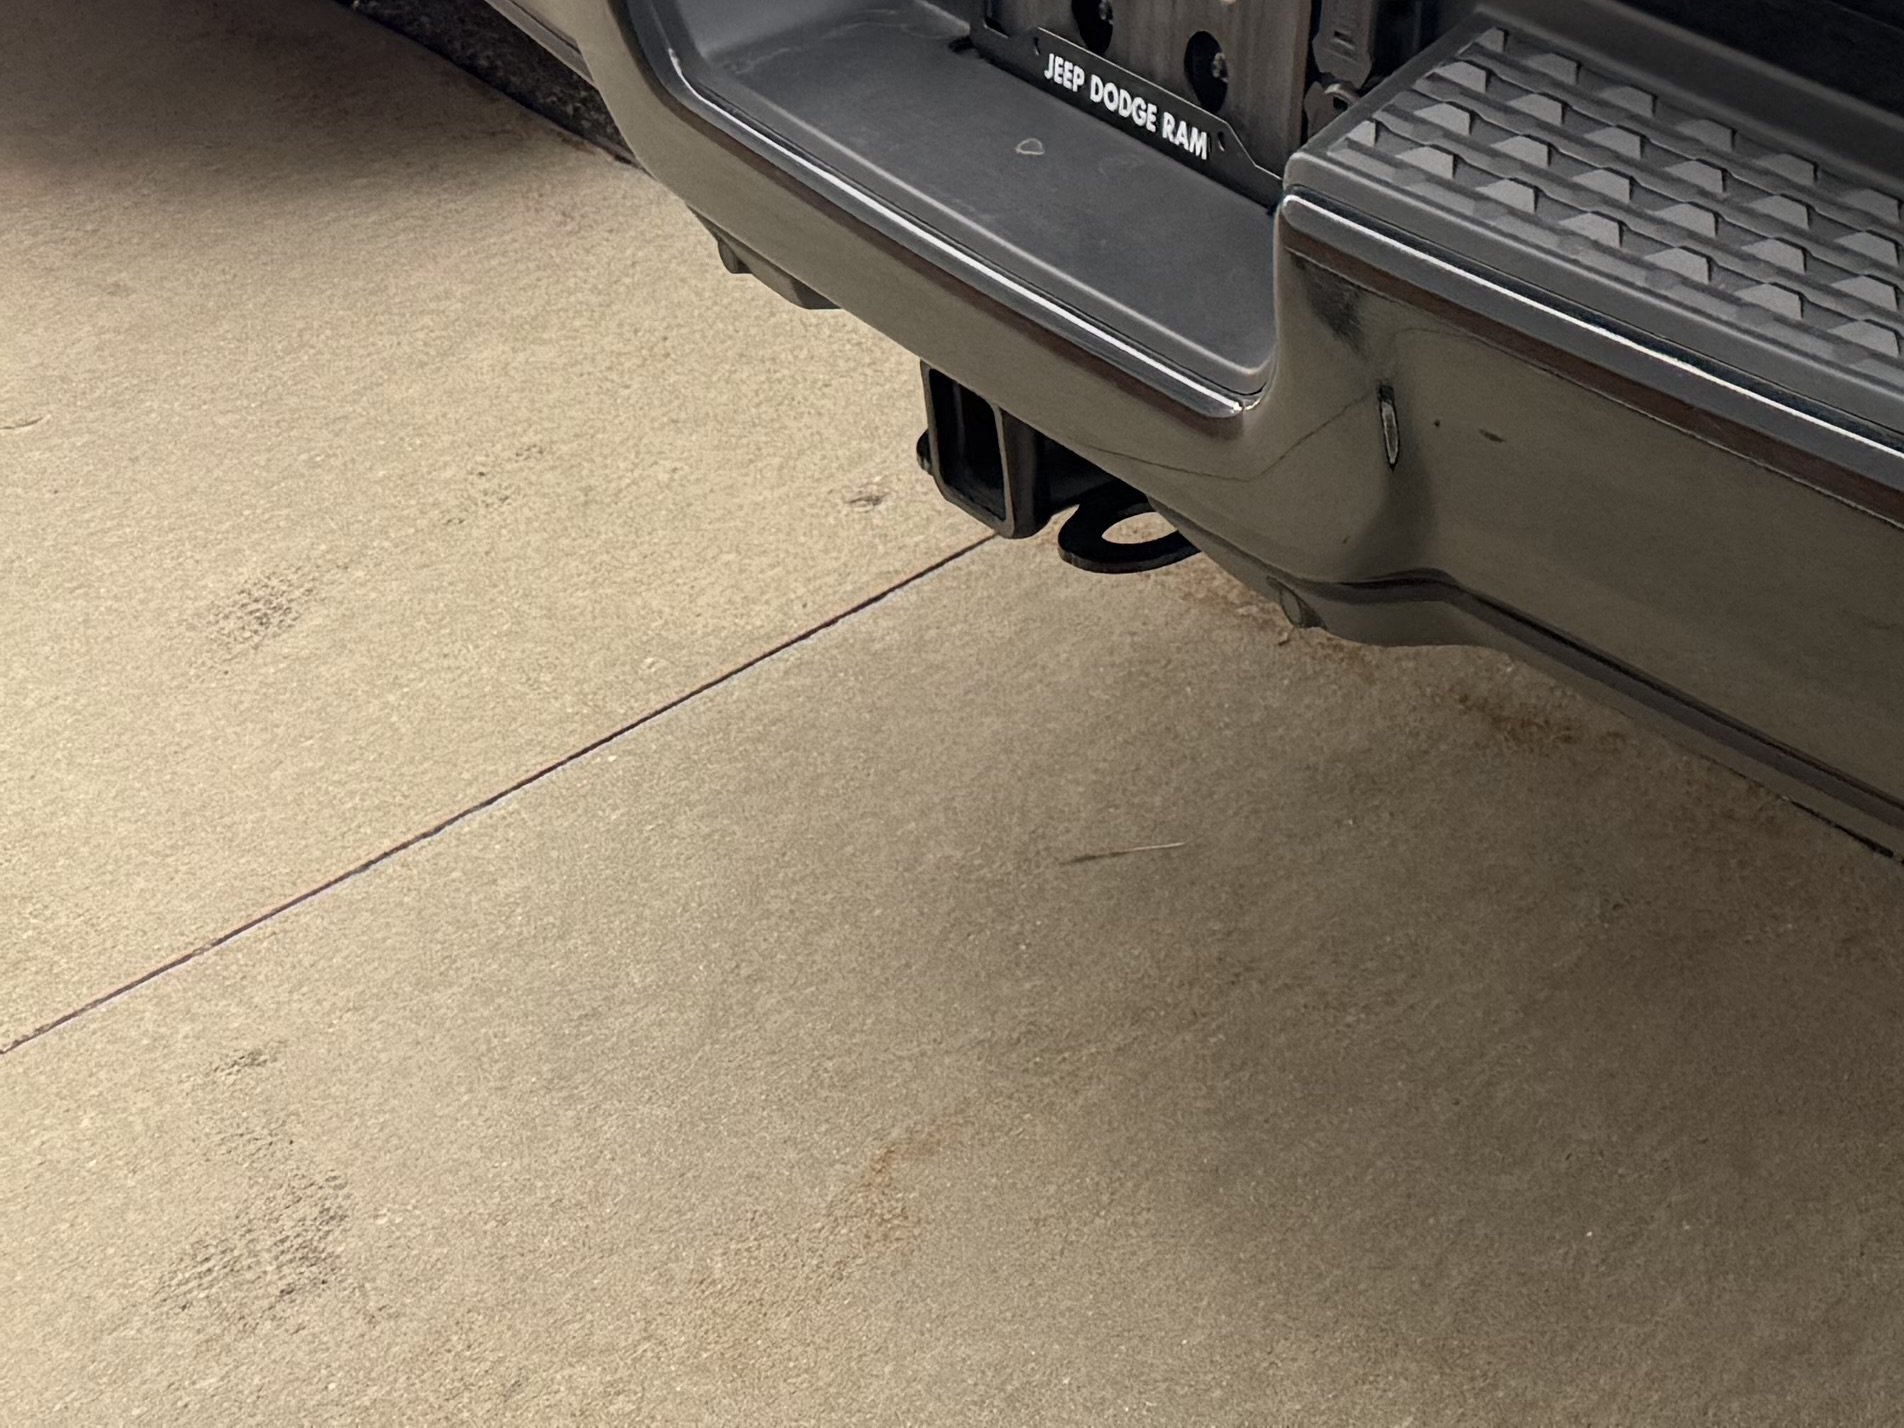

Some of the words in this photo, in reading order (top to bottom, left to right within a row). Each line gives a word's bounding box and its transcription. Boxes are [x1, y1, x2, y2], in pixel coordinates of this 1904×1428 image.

[1043, 52, 1085, 93] JEEP
[1089, 74, 1160, 136] DODGE
[1160, 110, 1210, 161] RAM
